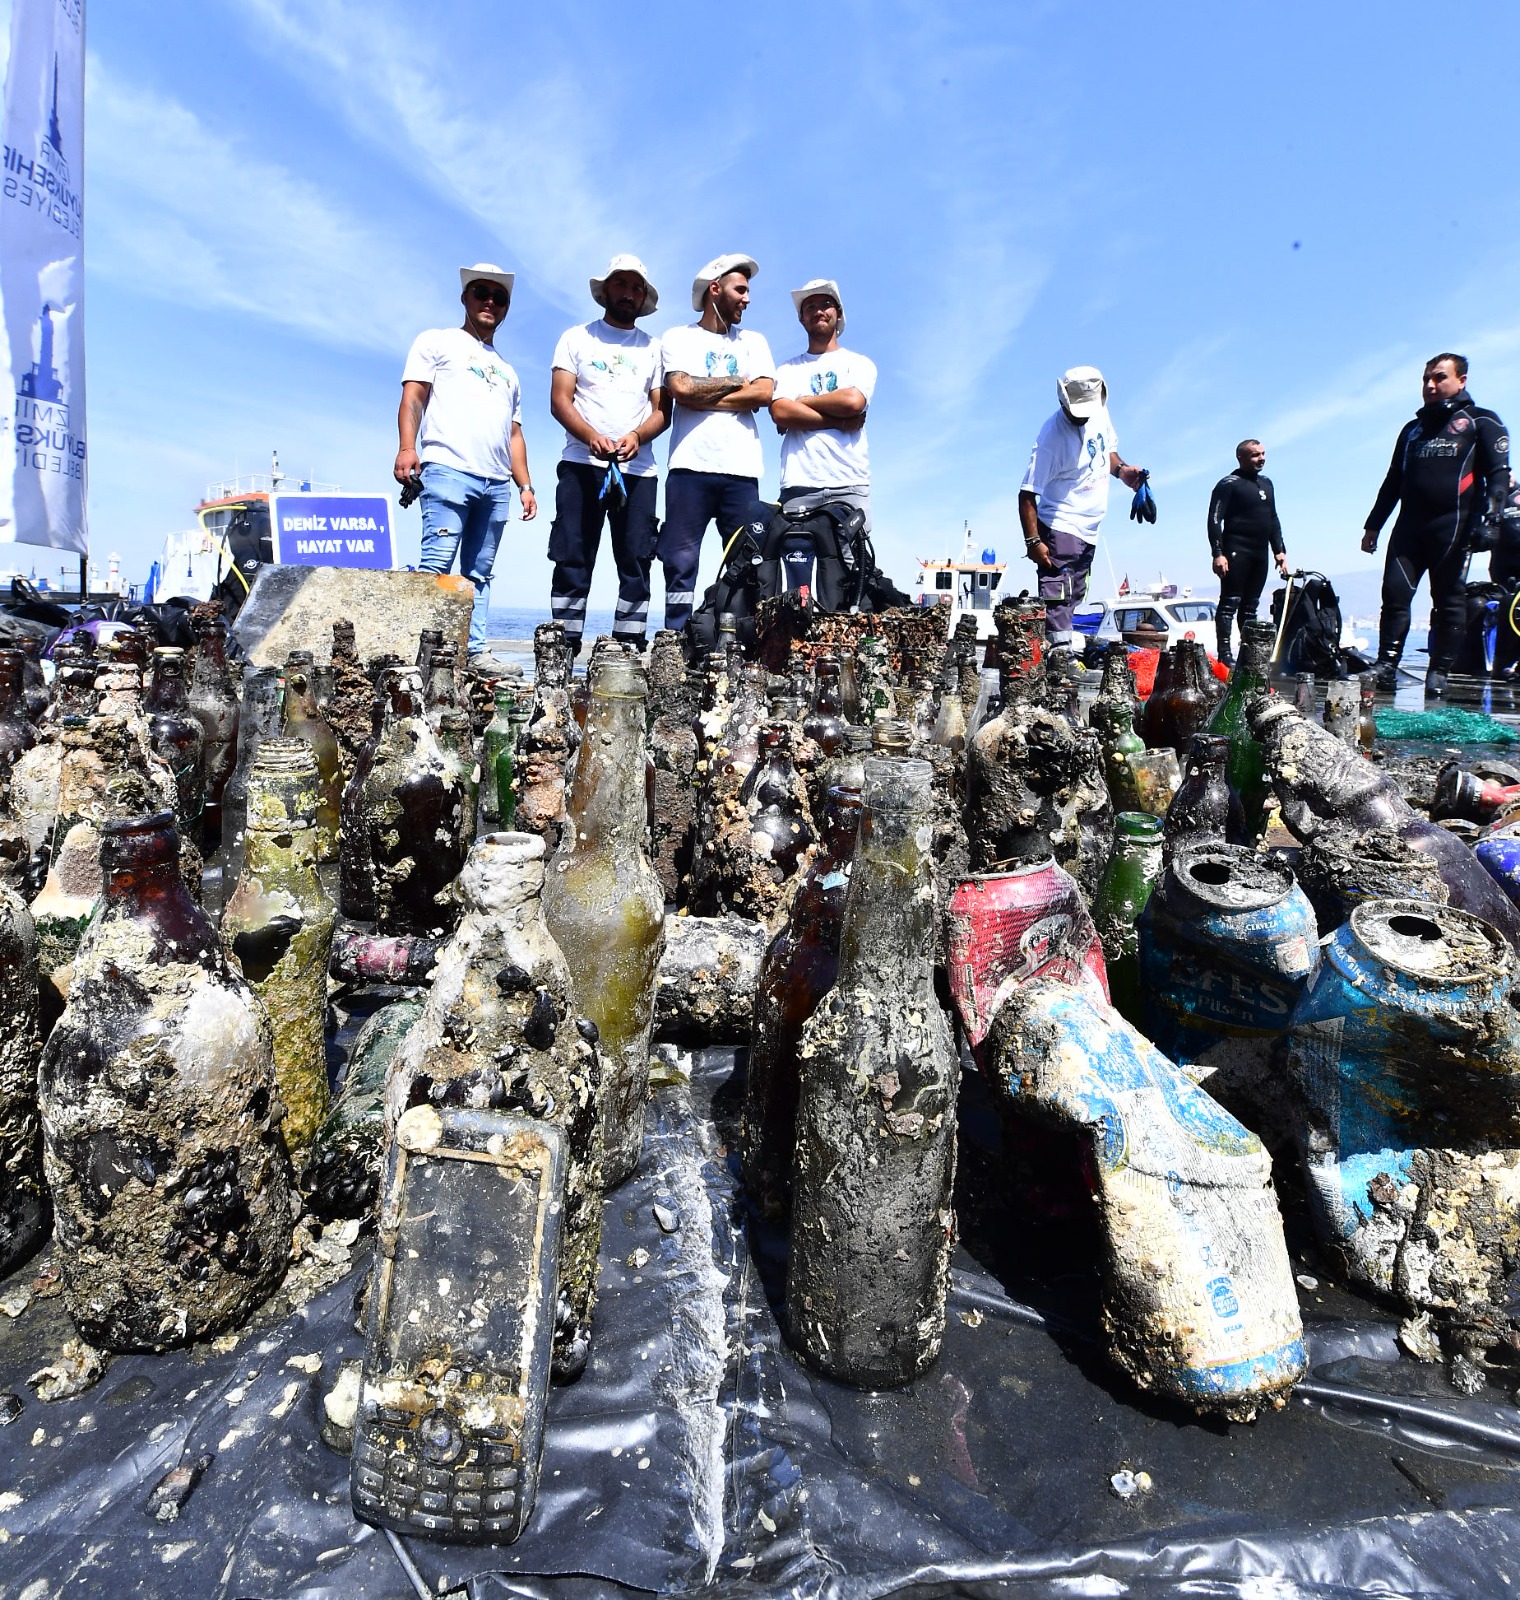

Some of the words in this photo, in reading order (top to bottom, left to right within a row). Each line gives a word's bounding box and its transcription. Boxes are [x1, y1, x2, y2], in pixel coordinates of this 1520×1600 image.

[283, 514, 328, 532] DENİZ
[296, 540, 343, 554] HAYAT
[345, 540, 375, 553] VAR
[1245, 921, 1279, 931] CERVEZA
[1199, 997, 1255, 1023] Pilsen
[363, 1476, 369, 1485] 6
[463, 1524, 473, 1532] FM
